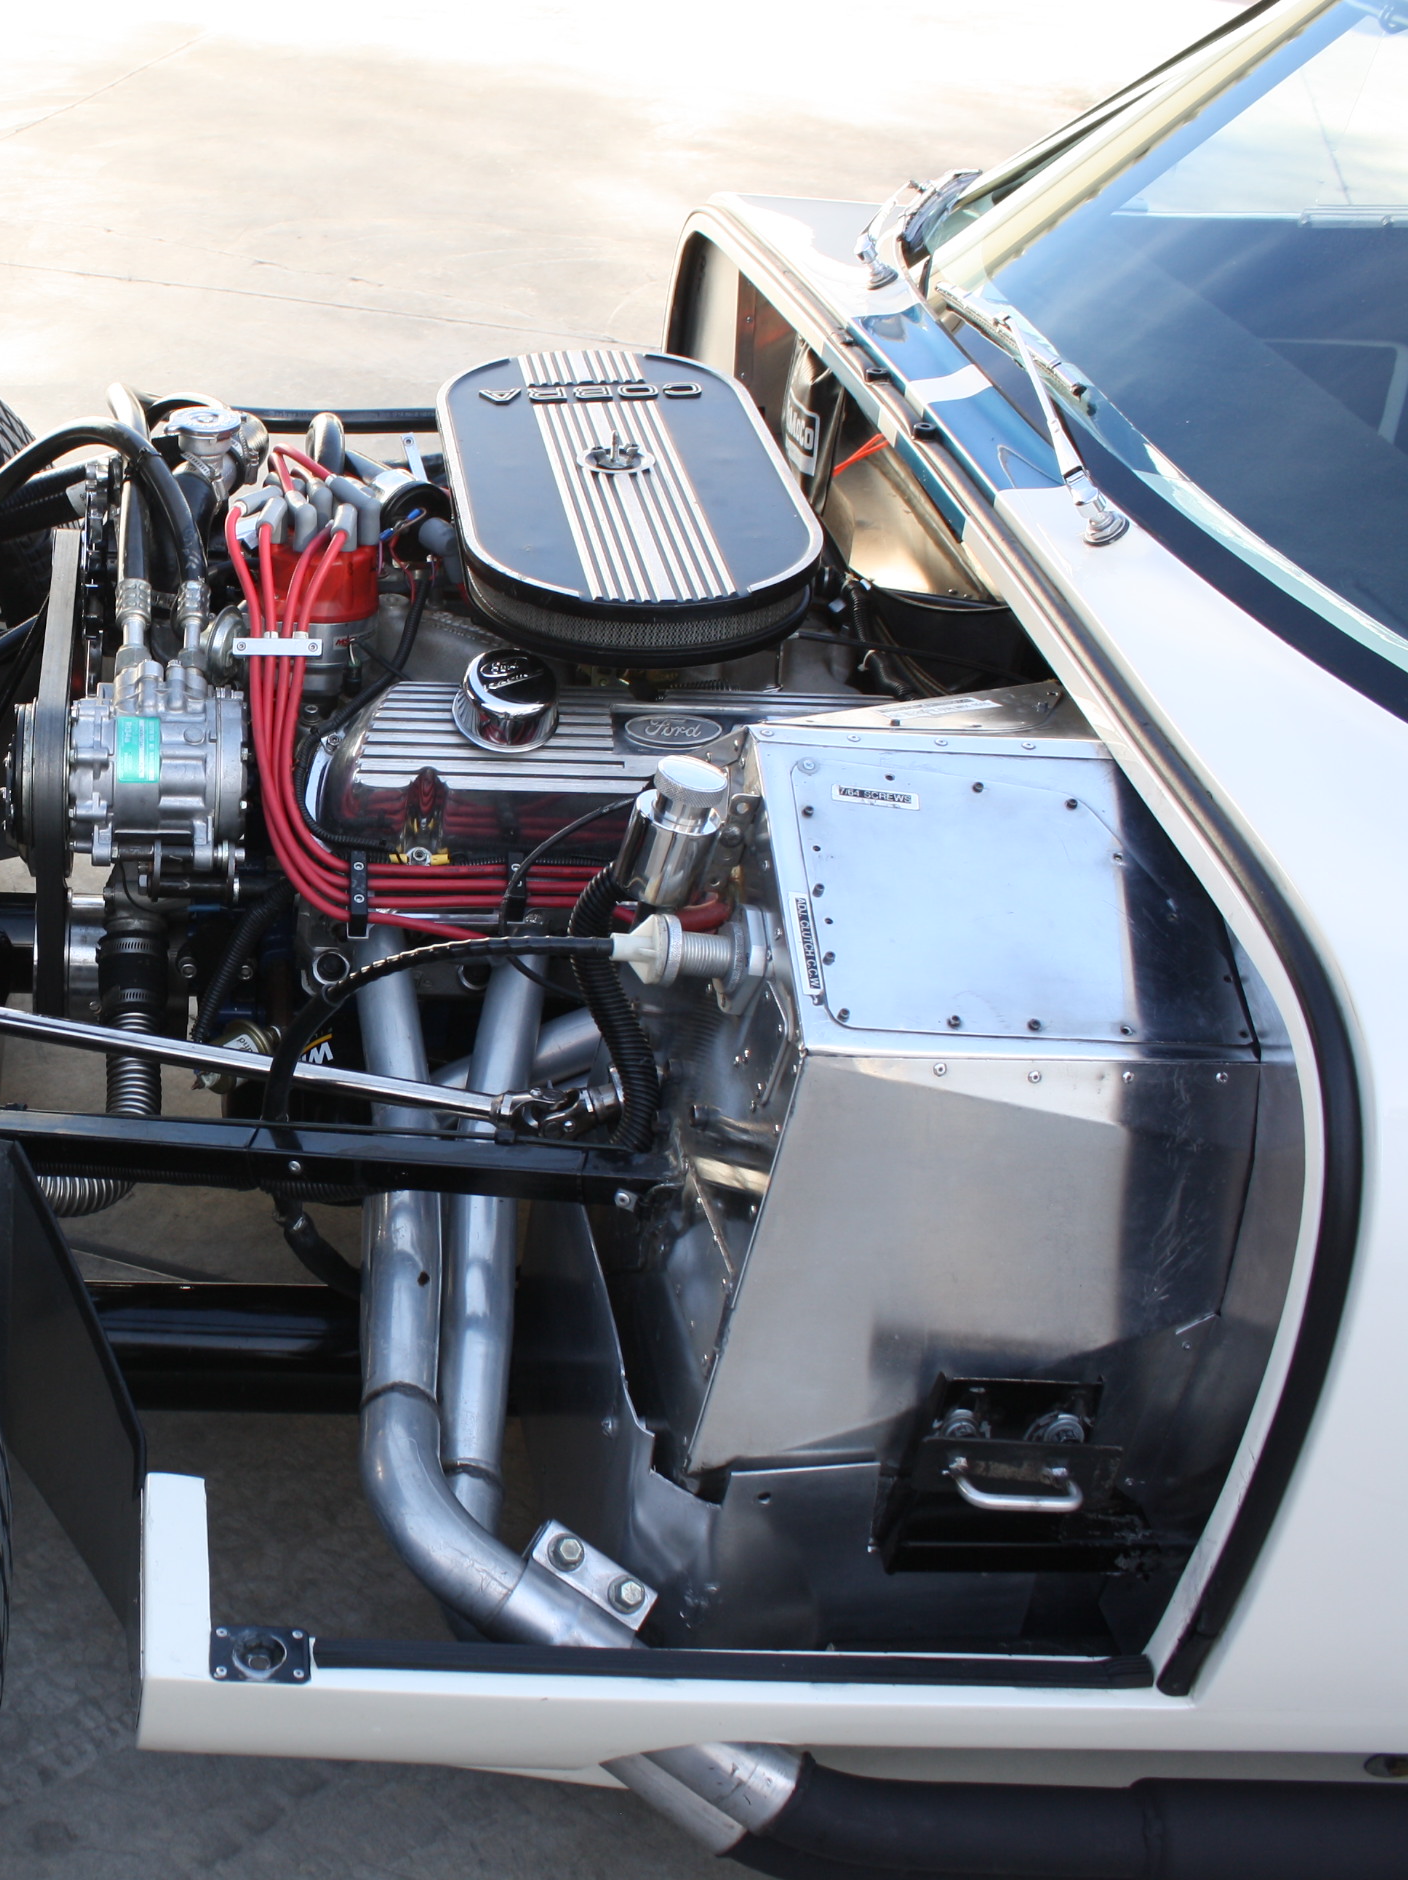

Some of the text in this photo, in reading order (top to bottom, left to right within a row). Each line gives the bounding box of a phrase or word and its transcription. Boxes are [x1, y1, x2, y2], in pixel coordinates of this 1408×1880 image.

[478, 382, 703, 405] COBRA
[645, 719, 702, 738] Ford
[839, 786, 912, 804] 7/64 SCREWS
[796, 897, 808, 917] ADJ.
[799, 920, 815, 957] CLUTCH
